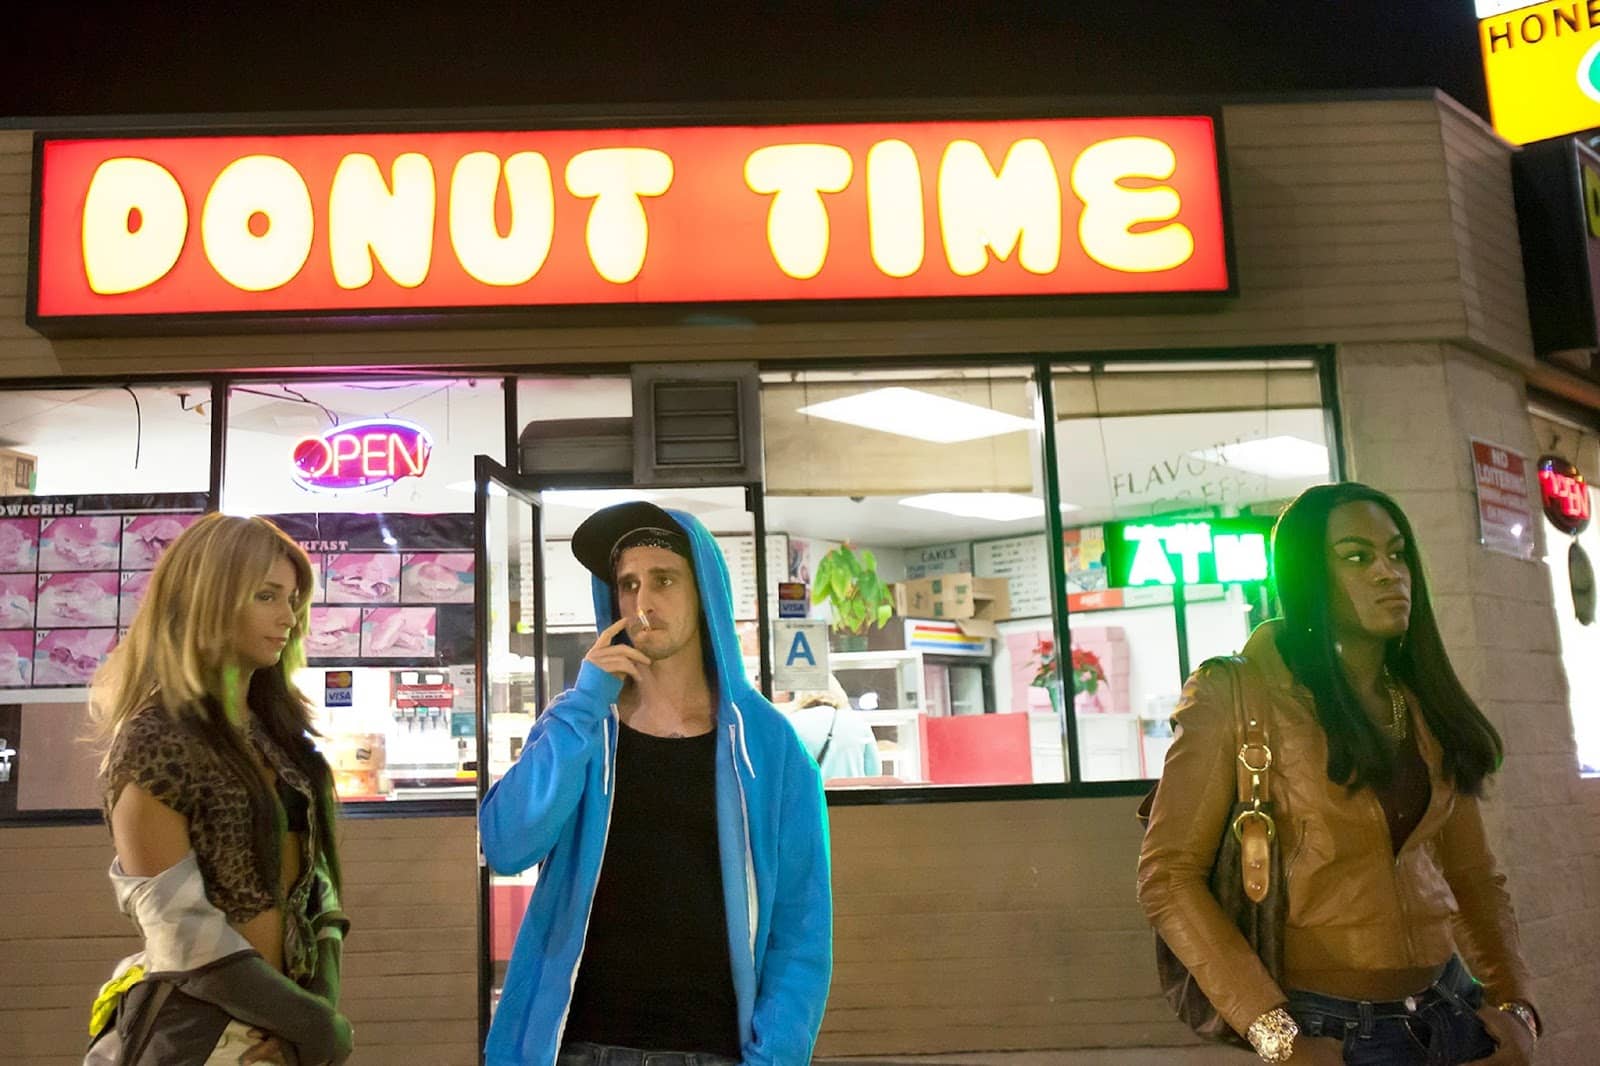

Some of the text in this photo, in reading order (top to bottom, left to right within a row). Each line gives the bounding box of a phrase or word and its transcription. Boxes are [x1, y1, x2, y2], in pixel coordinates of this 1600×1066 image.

[81, 136, 1195, 296] DONUT TIME
[289, 433, 425, 478] OPEN
[1490, 447, 1509, 470] NO
[1125, 527, 1268, 586] ATM
[782, 603, 804, 612] VISA
[785, 630, 817, 666] A
[328, 691, 351, 700] VISA
